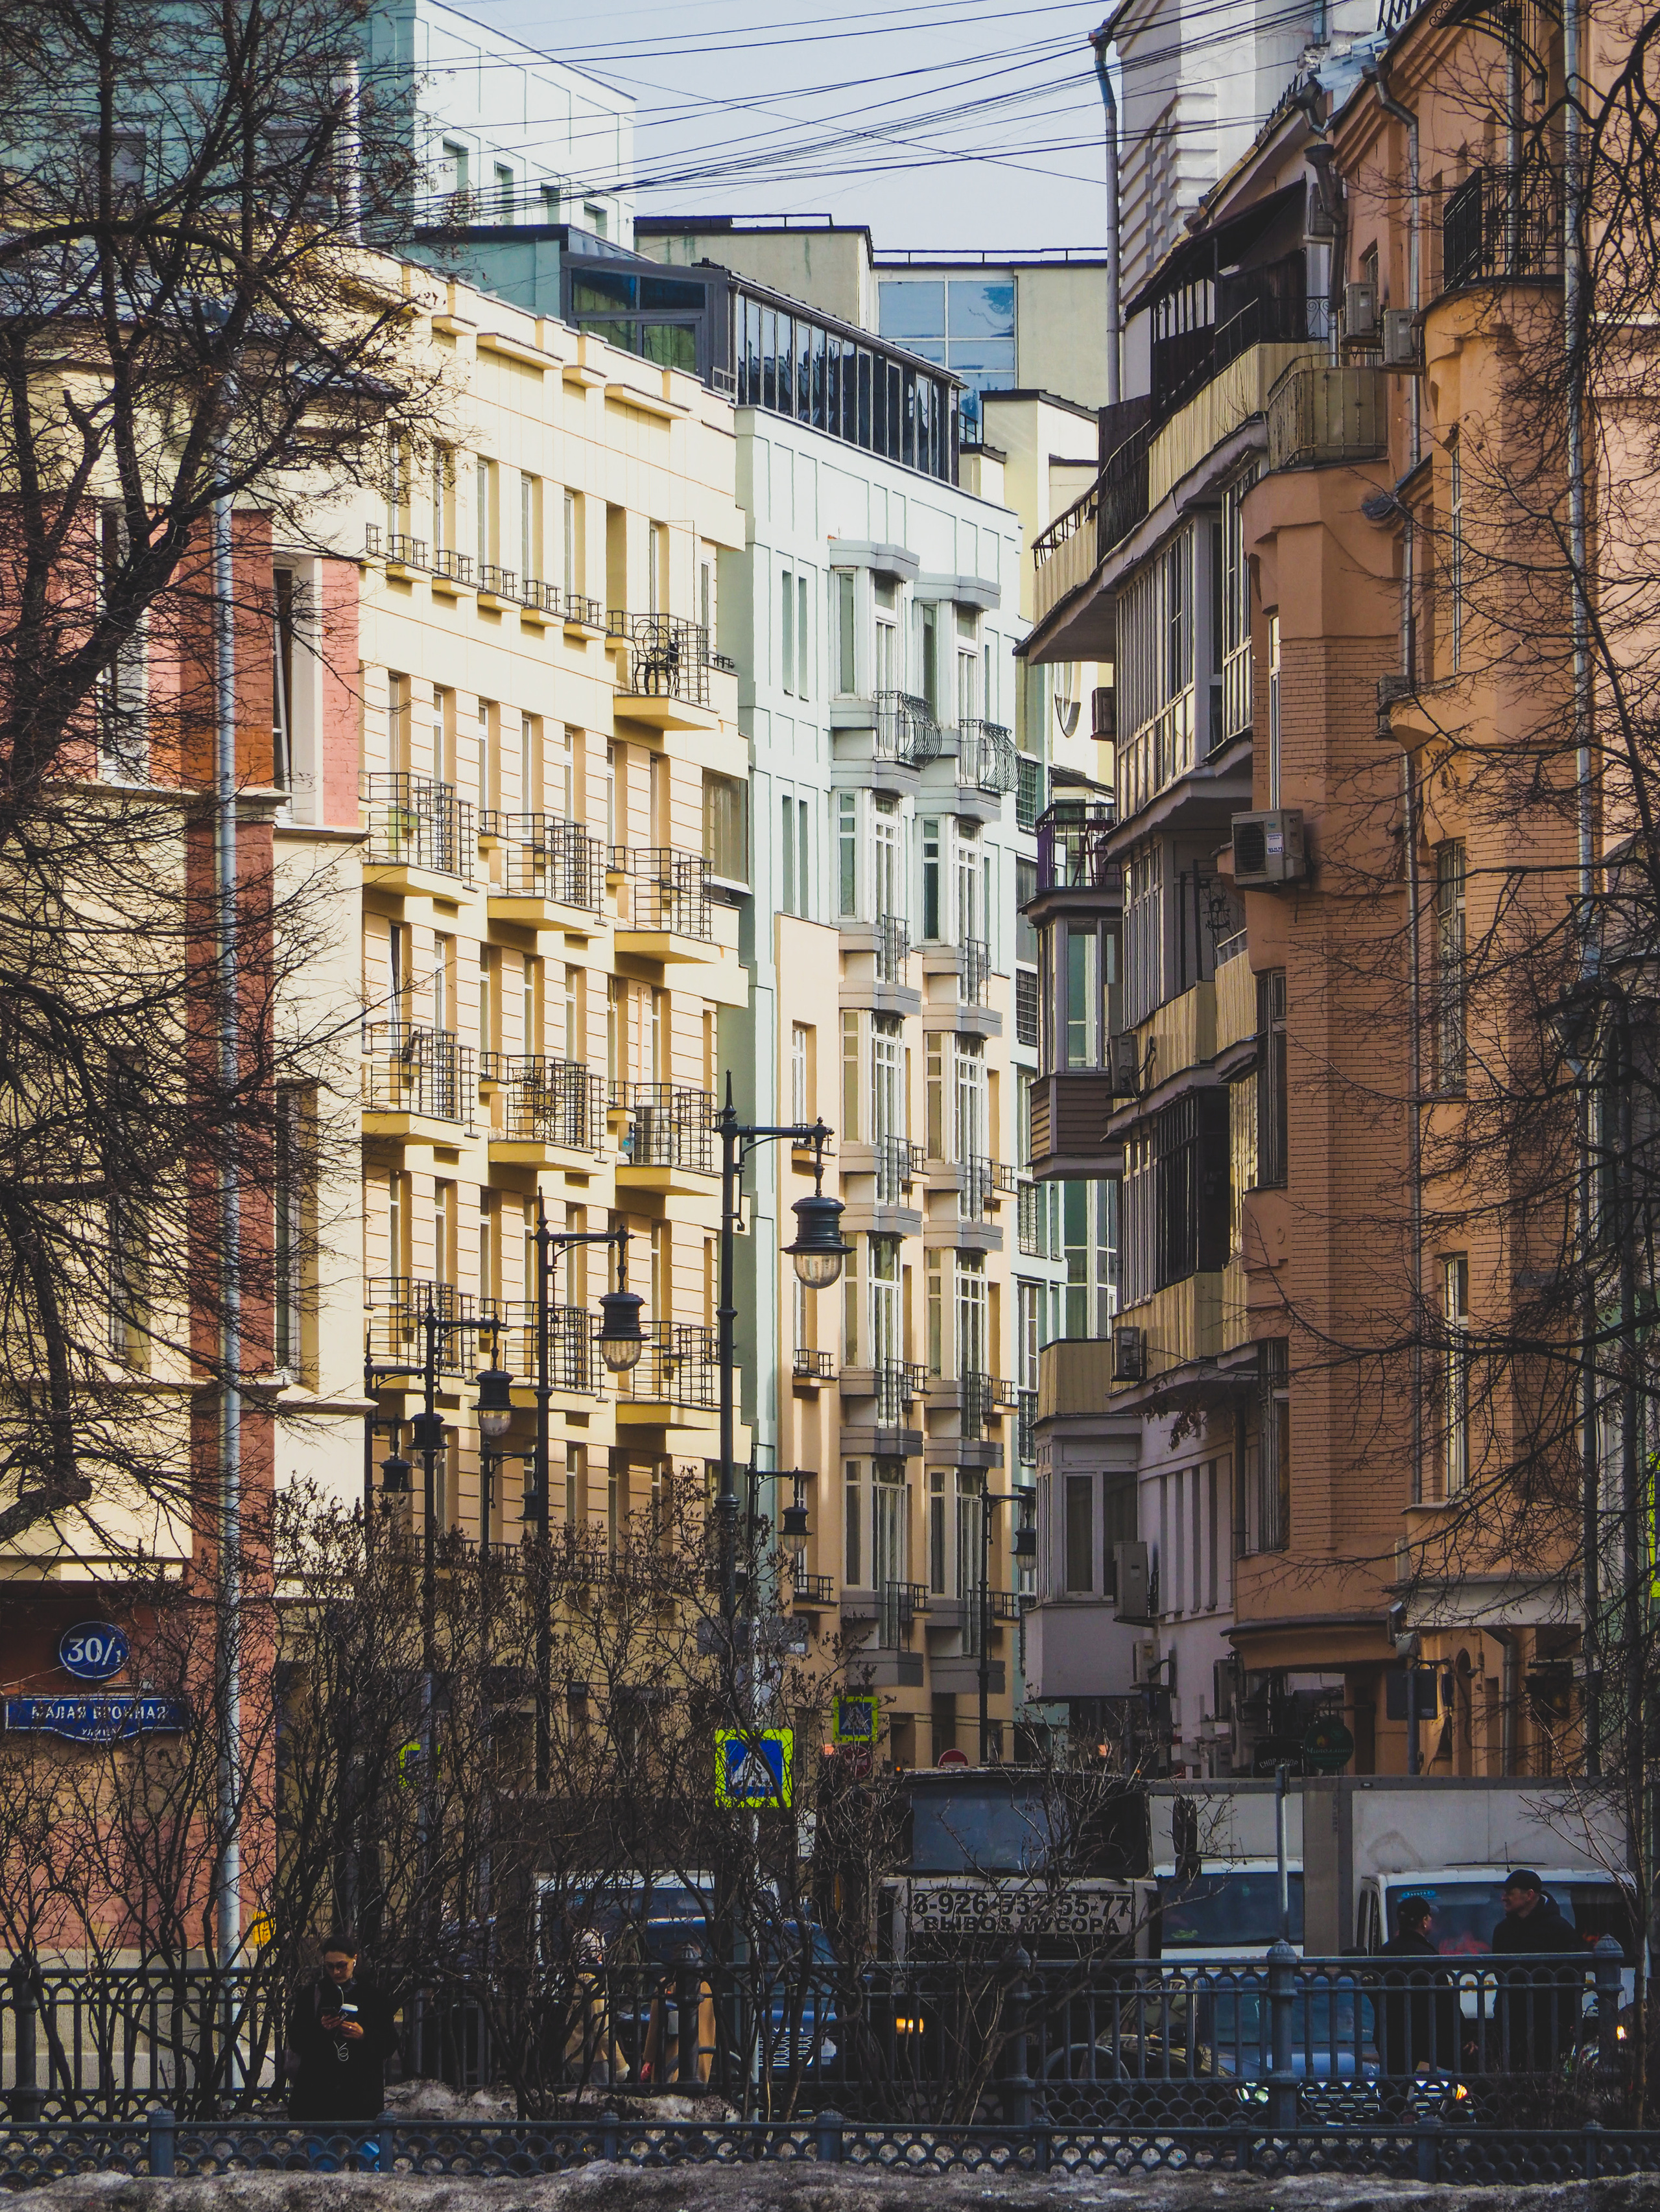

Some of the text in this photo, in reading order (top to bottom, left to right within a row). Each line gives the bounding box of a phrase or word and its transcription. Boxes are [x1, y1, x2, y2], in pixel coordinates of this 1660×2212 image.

[67, 1637, 121, 1665] 30/1
[32, 1706, 86, 1719] МАЛАЯ
[1259, 1758, 1299, 1769] CHOP-CHOP
